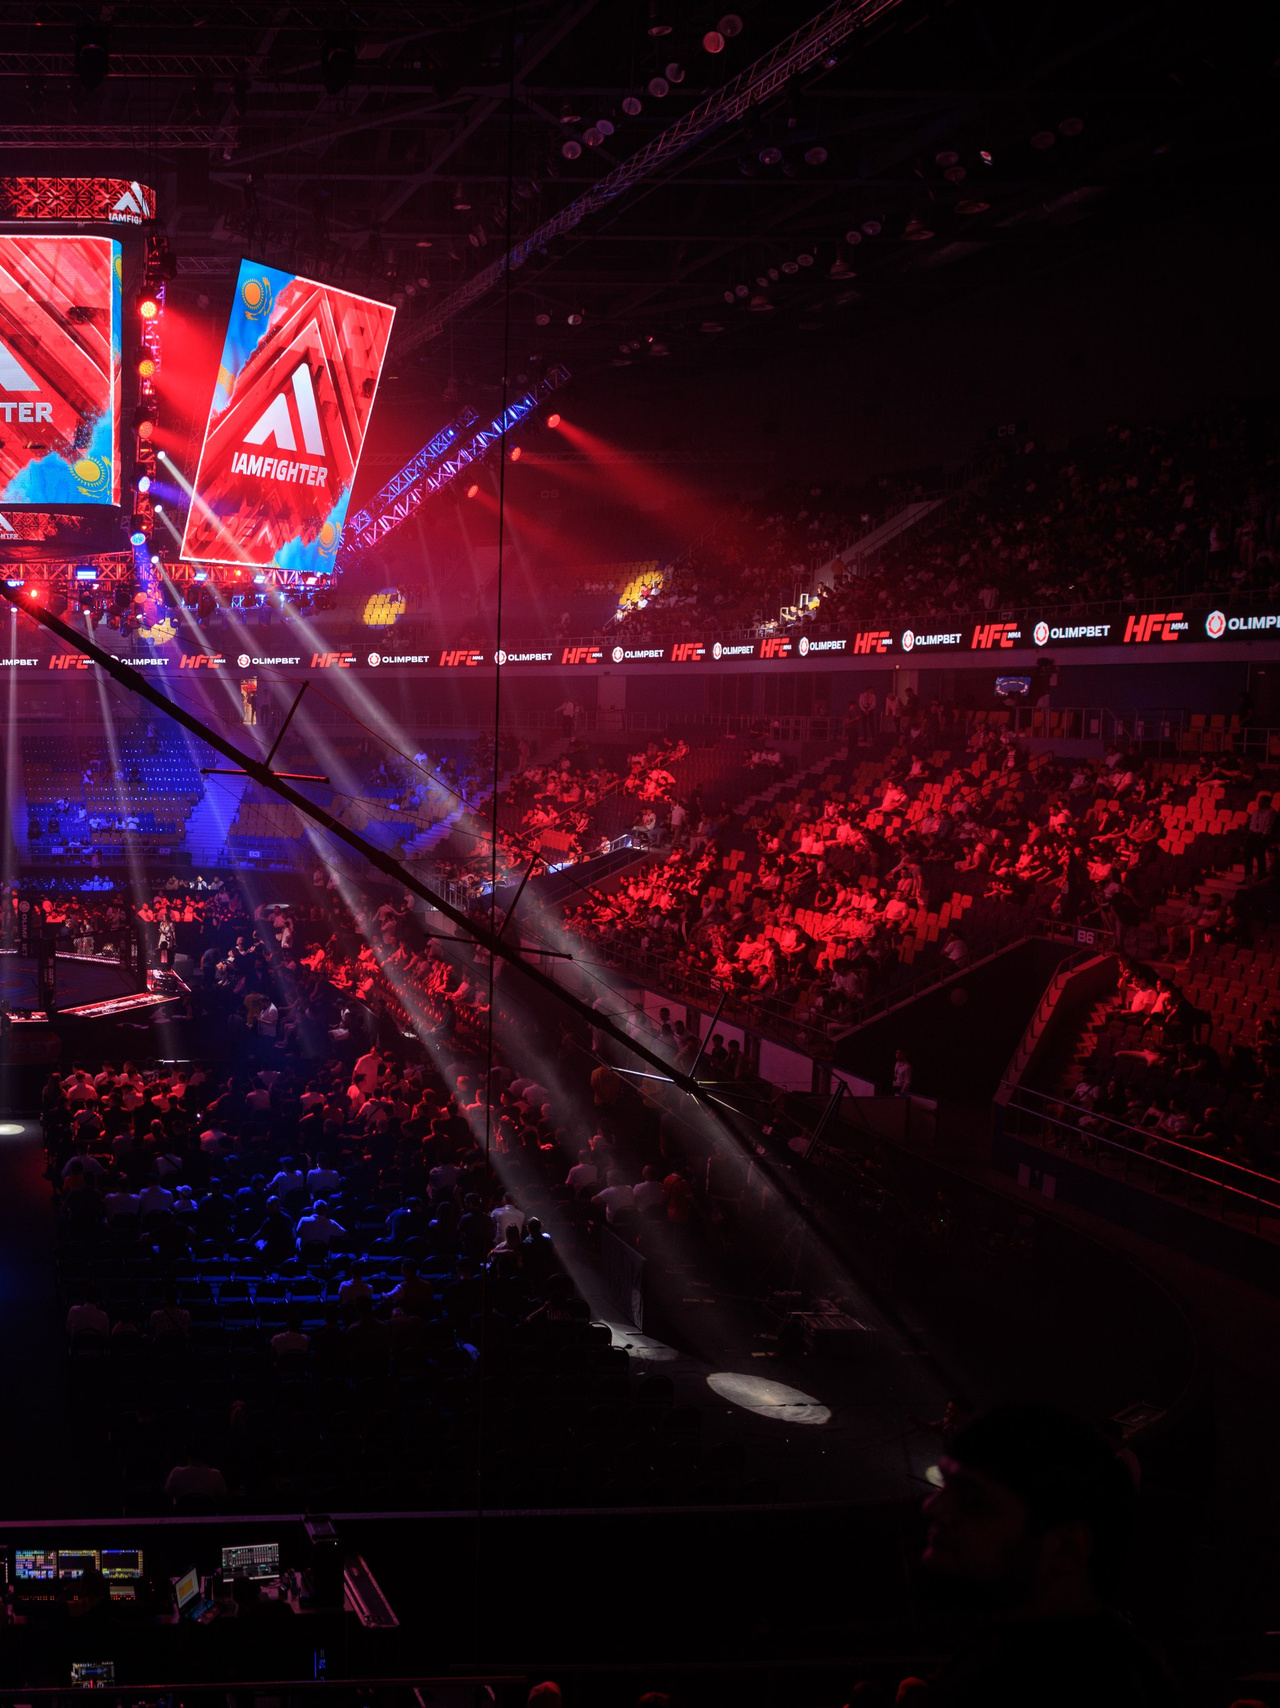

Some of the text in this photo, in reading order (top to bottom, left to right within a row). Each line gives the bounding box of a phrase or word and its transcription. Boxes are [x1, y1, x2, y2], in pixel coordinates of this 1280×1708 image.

[231, 452, 328, 487] IAMFIGHTER
[1050, 624, 1110, 639] OLIMPBET
[1124, 613, 1189, 642] HFC MMA
[854, 631, 889, 653] HFC
[915, 633, 961, 646] OLIMPBET
[972, 623, 1021, 648] HFC MMA
[671, 643, 703, 661] HFC
[723, 645, 754, 655] OLIMPBET
[760, 638, 789, 658] HFC
[809, 638, 846, 653] OLIMPBET
[180, 654, 222, 668] HFC
[252, 657, 300, 665] OLIMPBET
[311, 653, 352, 667] HFC
[382, 655, 429, 664] OLIMPBET
[440, 650, 480, 666] HFC
[508, 652, 552, 662] OLIMPBET
[562, 647, 599, 664] HFC
[624, 649, 664, 659] OLIMPBET
[49, 655, 90, 669] HFC
[121, 658, 169, 666] OLIMPBET
[1078, 930, 1095, 944] B6
